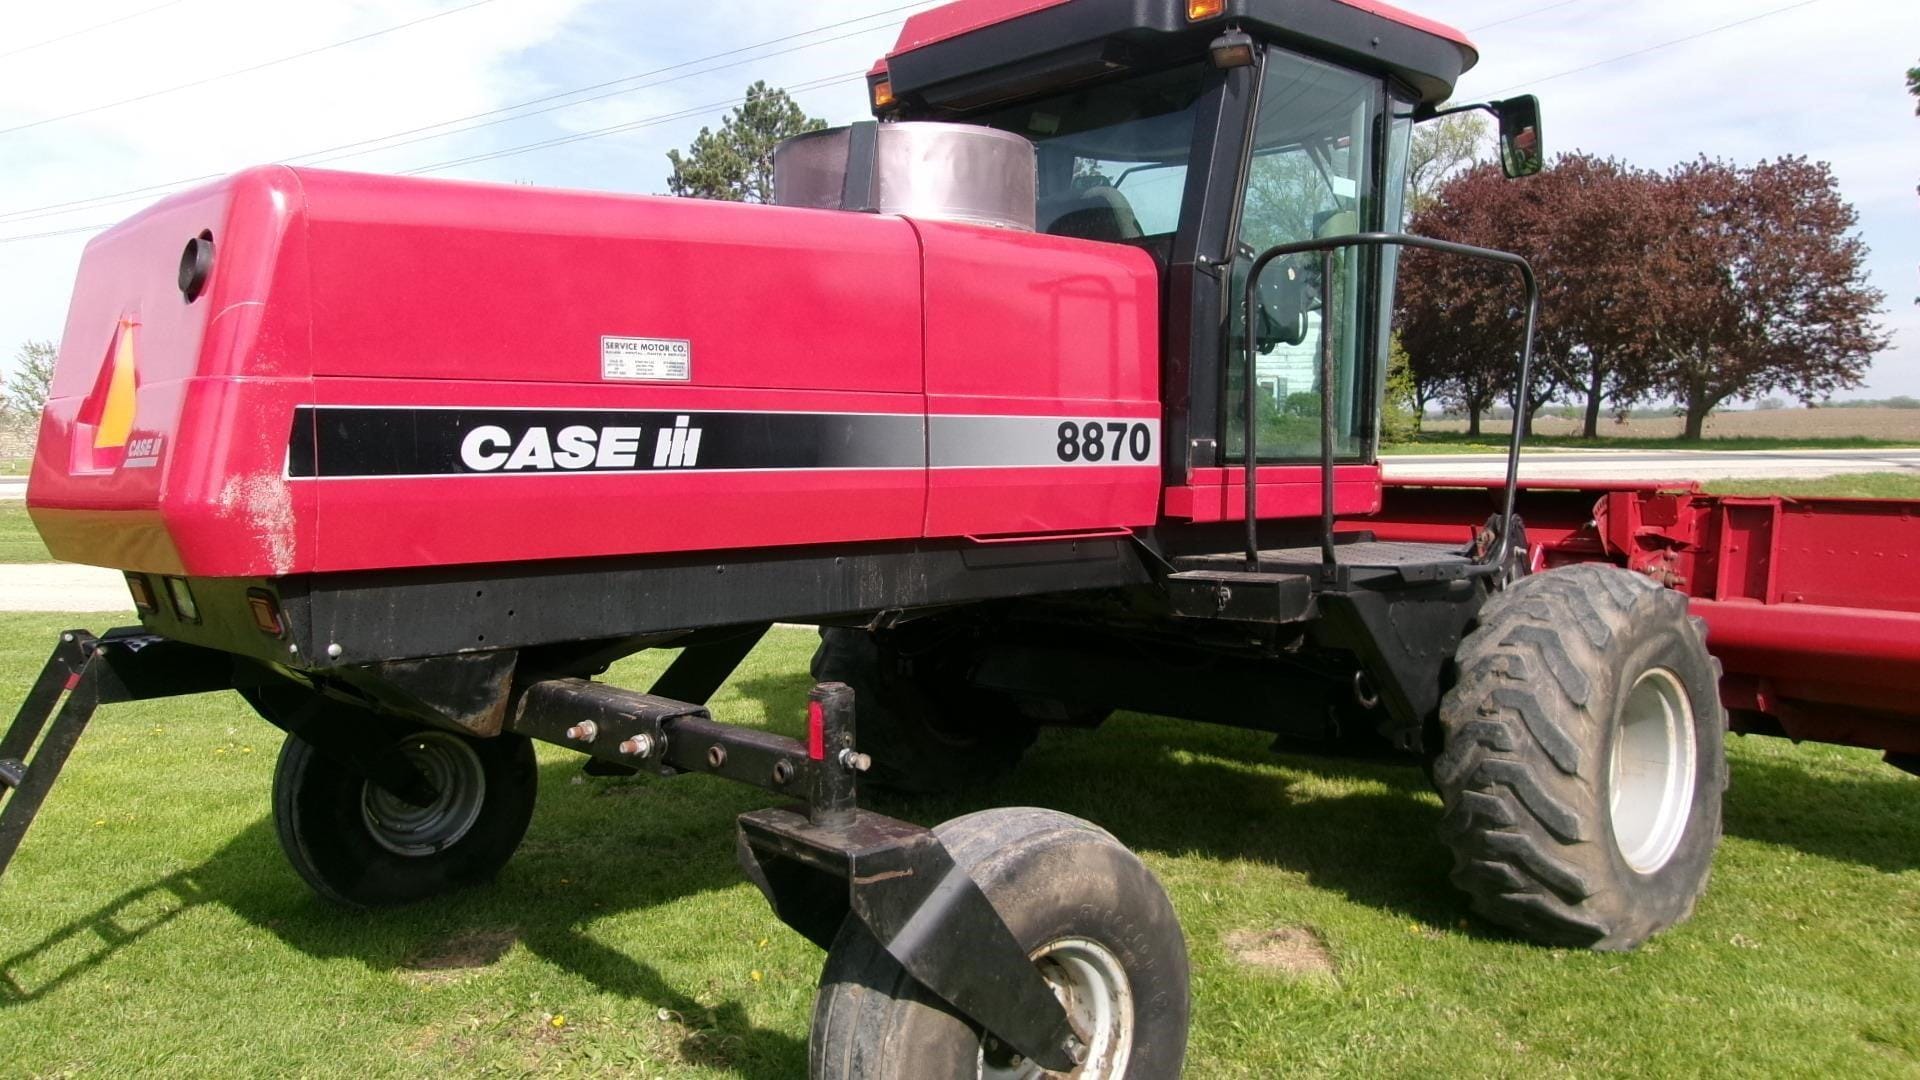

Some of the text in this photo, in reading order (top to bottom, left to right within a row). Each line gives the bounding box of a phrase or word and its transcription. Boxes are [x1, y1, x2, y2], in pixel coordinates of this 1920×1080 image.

[605, 342, 687, 353] SERVICE MOTOR CO.
[127, 439, 153, 457] CASE
[460, 425, 642, 471] CASE
[1056, 421, 1151, 462] 8870
